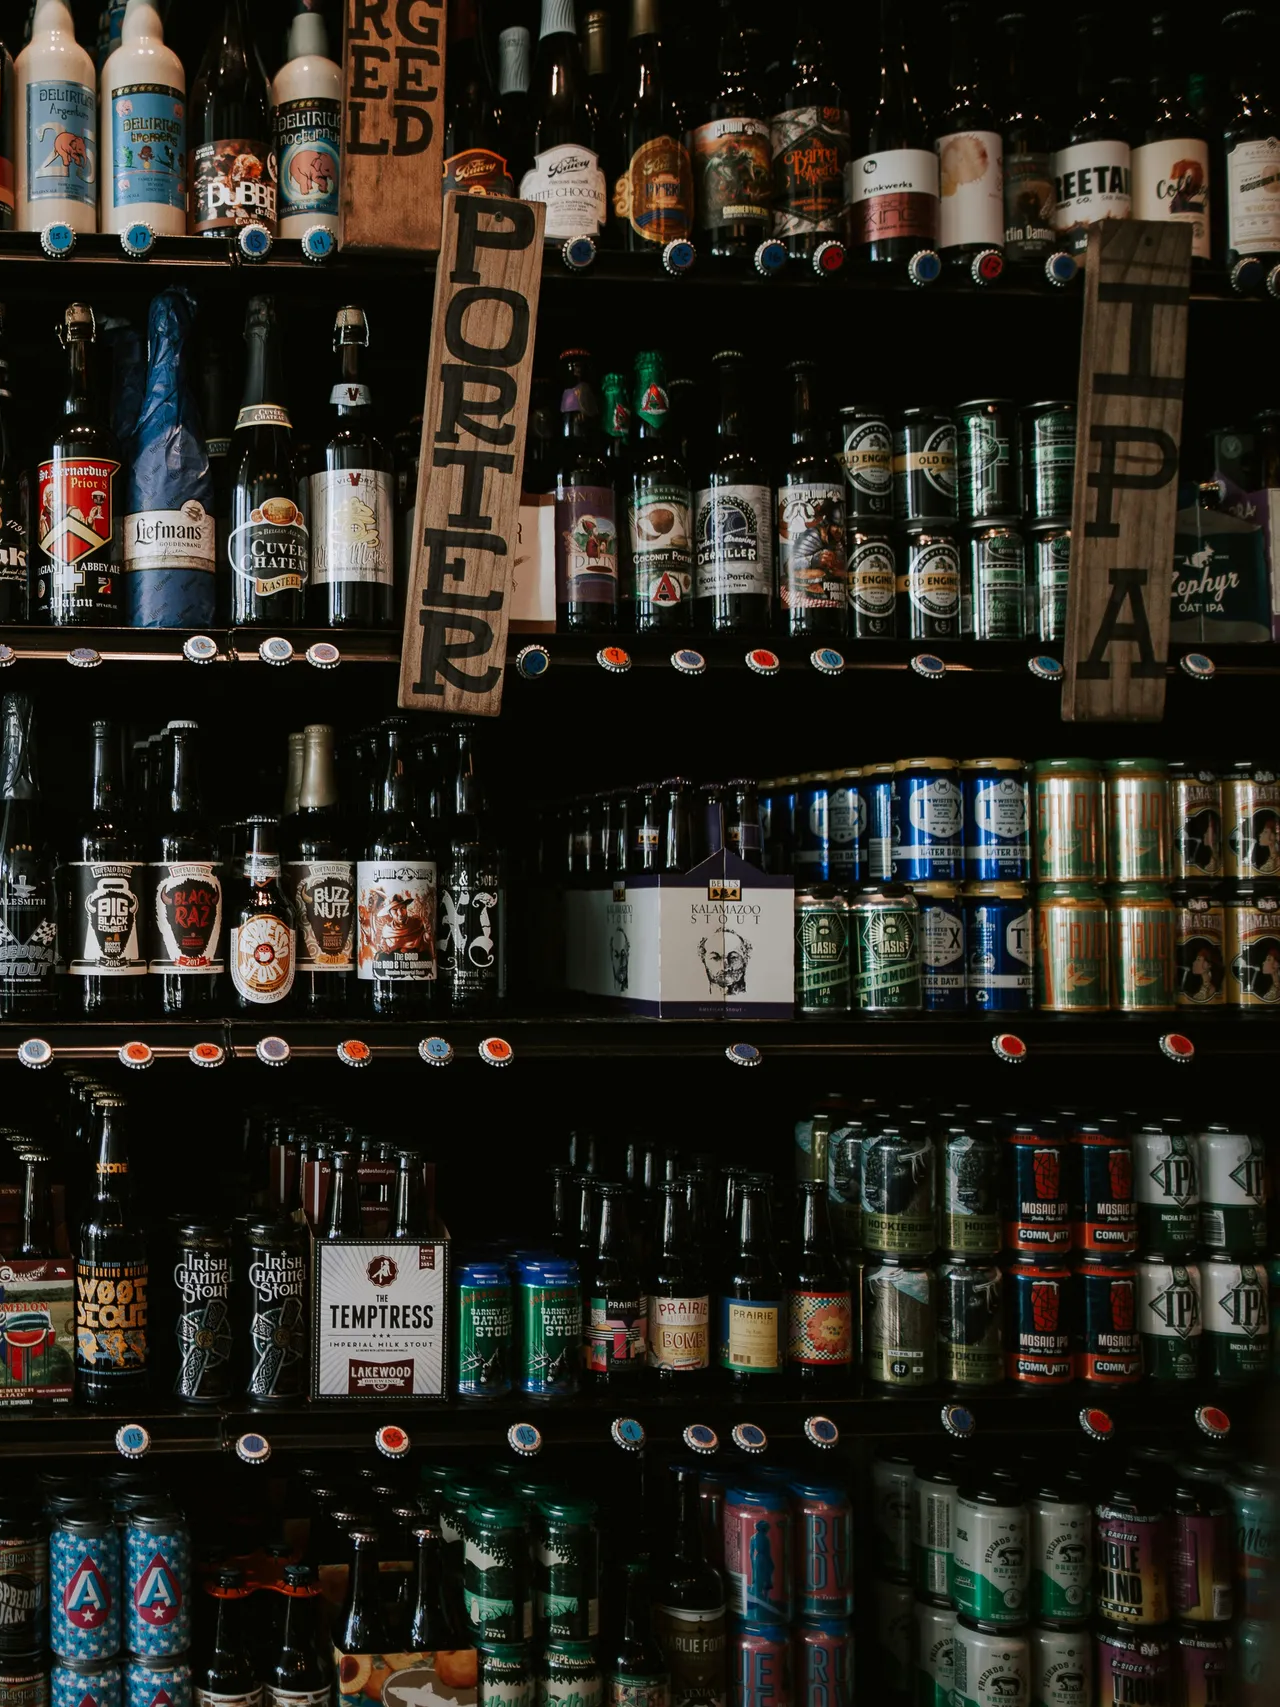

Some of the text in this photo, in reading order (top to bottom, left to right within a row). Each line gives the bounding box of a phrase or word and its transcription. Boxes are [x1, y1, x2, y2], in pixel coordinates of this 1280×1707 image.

[864, 181, 913, 195] funkwerks
[412, 193, 536, 696] PORTER
[919, 455, 940, 465] OLD
[1077, 282, 1191, 679] IPA
[135, 519, 203, 545] Liefmans
[159, 541, 201, 549] GOUDENBAND
[262, 577, 300, 592] KASTEEL
[1179, 603, 1224, 613] OAT IPA
[174, 890, 212, 907] BLACK
[315, 886, 348, 903] BUZZ
[98, 898, 127, 917] BIG
[314, 902, 351, 919] NUTZ
[691, 904, 761, 914] KALAMAZOO
[98, 916, 128, 927] BLACK
[175, 906, 209, 929] RAZ
[691, 915, 760, 925] STOUT
[98, 923, 128, 932] COWBELL
[811, 941, 837, 954] OASIS
[878, 941, 905, 953] OASIS
[1097, 1203, 1130, 1215] MOSAIC
[1019, 1229, 1069, 1244] COMMUNITY
[608, 1300, 638, 1309] PRAIRIE
[659, 1300, 708, 1315] PRAIRIE
[329, 1305, 433, 1328] TEMPTRESS
[733, 1310, 773, 1320] PRAIRIE
[662, 1331, 706, 1348] BOMB!
[1098, 1334, 1130, 1346] MOSAIC
[351, 1367, 411, 1378] LAKEWOOD
[67, 1570, 106, 1610] A
[138, 1567, 177, 1611] A
